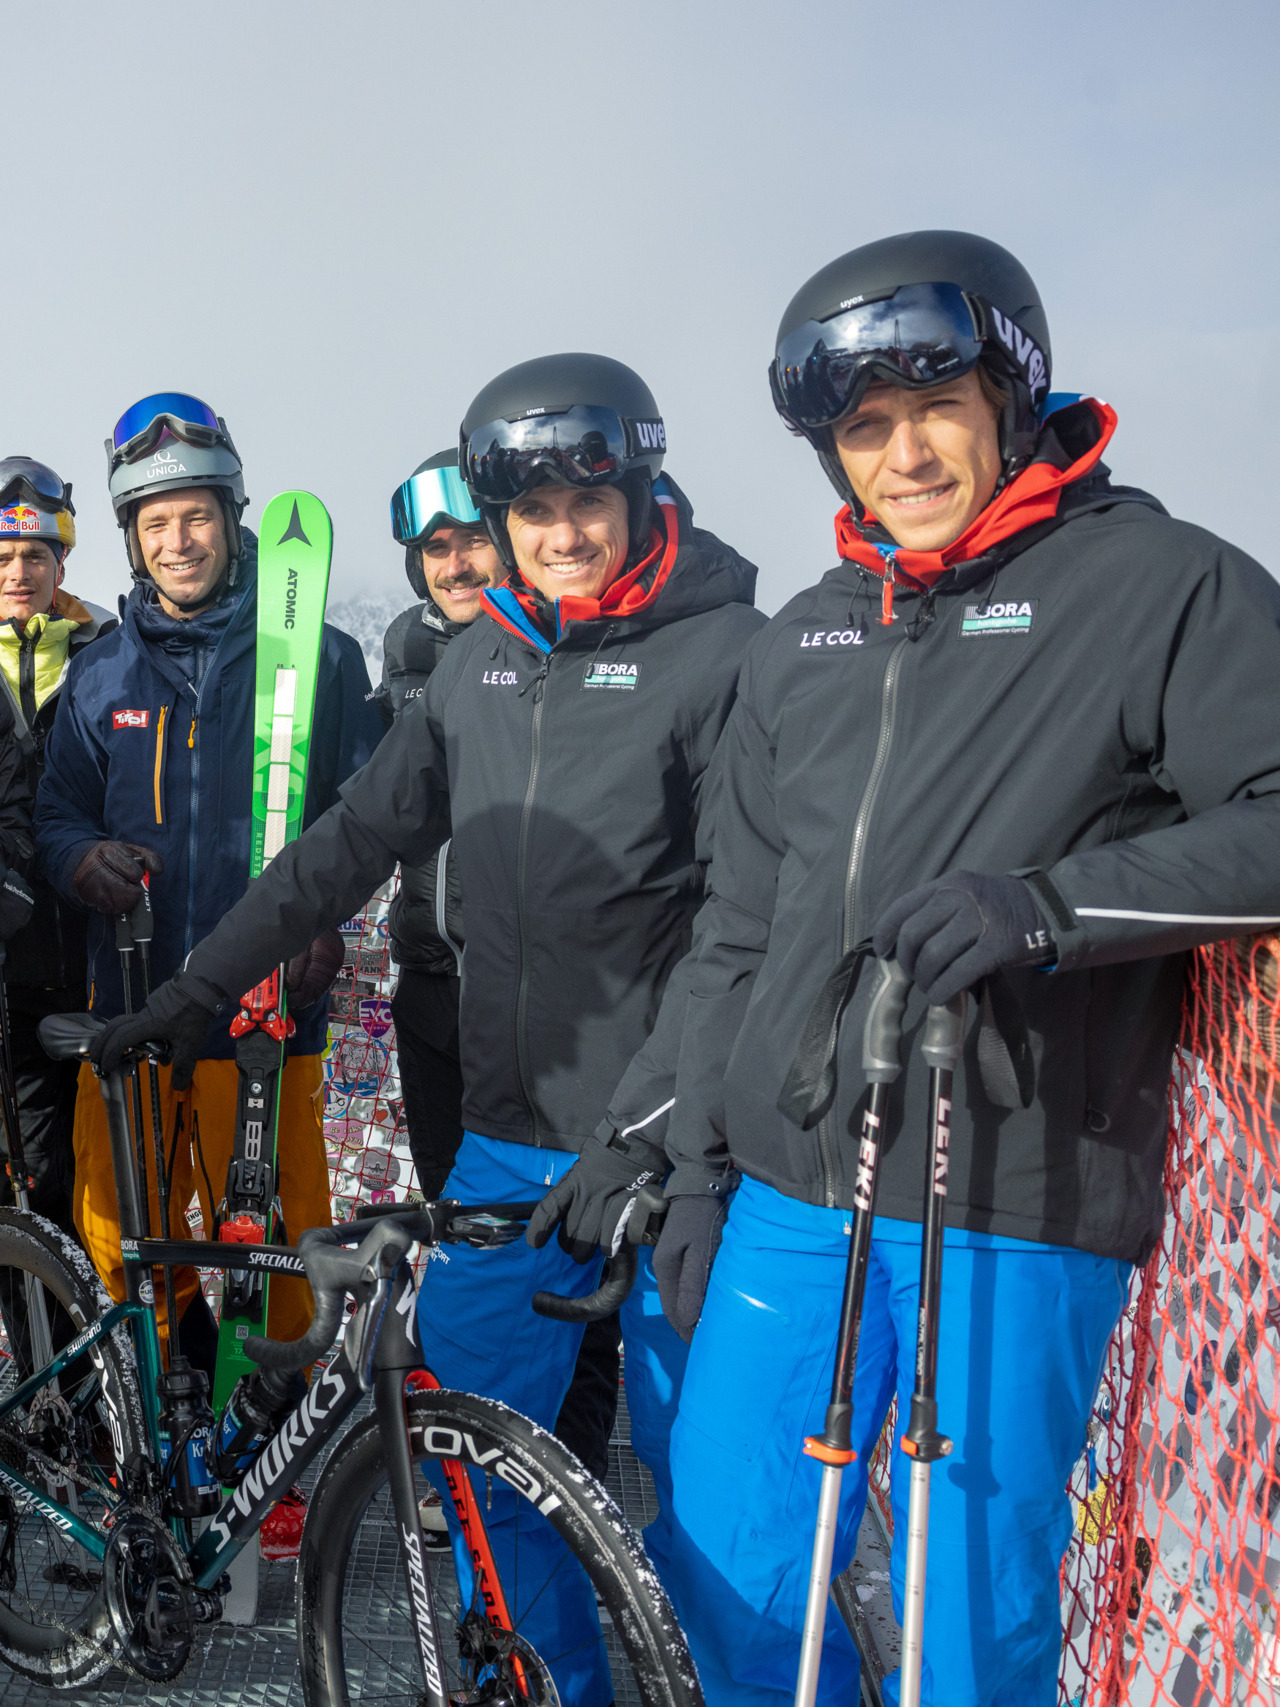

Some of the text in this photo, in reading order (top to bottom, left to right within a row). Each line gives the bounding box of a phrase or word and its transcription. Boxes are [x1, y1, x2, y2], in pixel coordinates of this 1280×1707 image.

[840, 294, 864, 309] uvex
[526, 407, 545, 416] uvex
[636, 422, 666, 448] uve
[146, 463, 187, 479] UNIQA
[0, 521, 40, 531] Red Bull
[284, 567, 298, 630] ATOMIC
[800, 630, 864, 647] LE COL
[482, 671, 518, 685] LE COL
[599, 663, 638, 676] BORA
[404, 688, 416, 699] LE
[253, 832, 263, 876] REDSTE
[144, 892, 152, 912] LEKI
[1026, 930, 1049, 950] LE
[933, 1096, 952, 1197] LEKI
[853, 1108, 880, 1212] LEKI
[637, 1169, 654, 1186] COL
[121, 1239, 139, 1251] BORA
[248, 1252, 307, 1273] SPECIALIZ
[67, 1322, 102, 1357] SHIMANO
[210, 1352, 346, 1554] S-WORKS
[402, 1522, 444, 1697] SPECIALIZED
